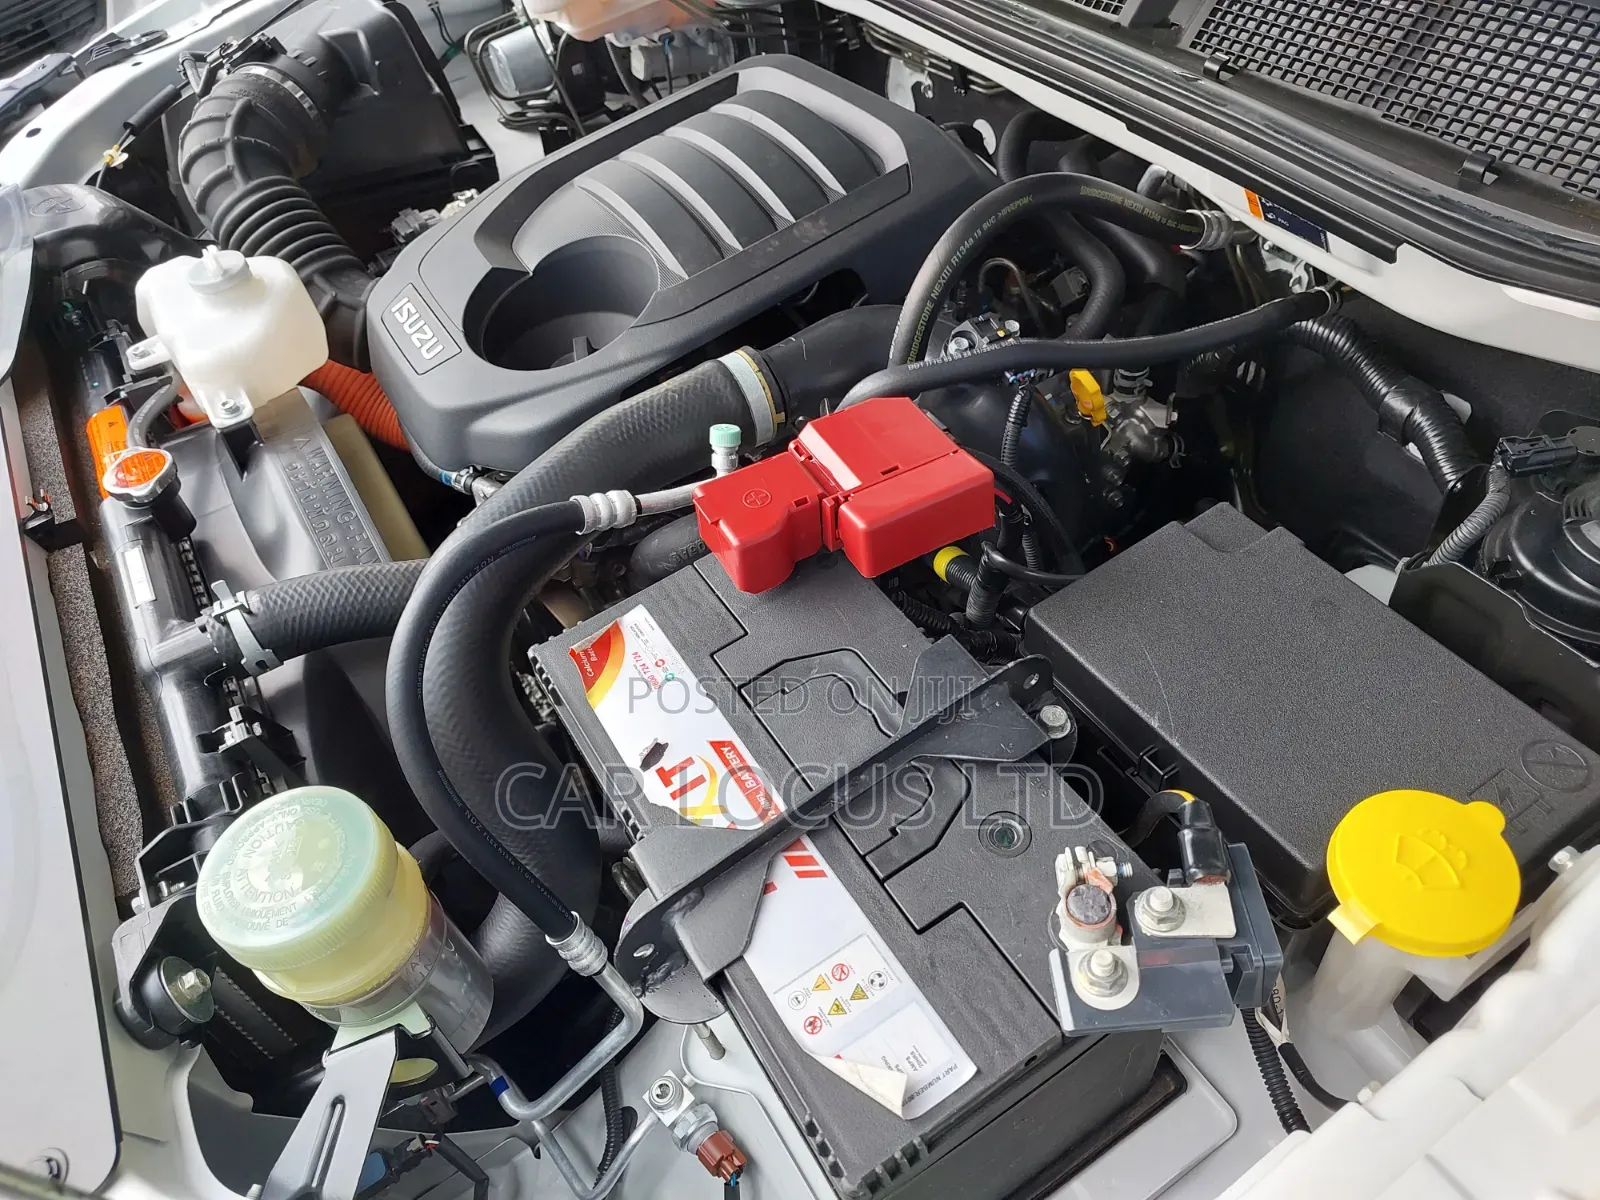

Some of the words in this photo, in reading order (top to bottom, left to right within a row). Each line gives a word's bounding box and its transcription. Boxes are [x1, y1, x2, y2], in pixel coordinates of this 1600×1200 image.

[391, 297, 444, 360] ISUZU
[576, 650, 595, 678] Calcium
[720, 745, 756, 789] BATTERY
[272, 807, 298, 823] ONLY
[464, 810, 482, 831] NDZ
[246, 818, 305, 859] CAUTION
[235, 868, 297, 903] ATTENTION
[941, 1062, 958, 1078] PART
